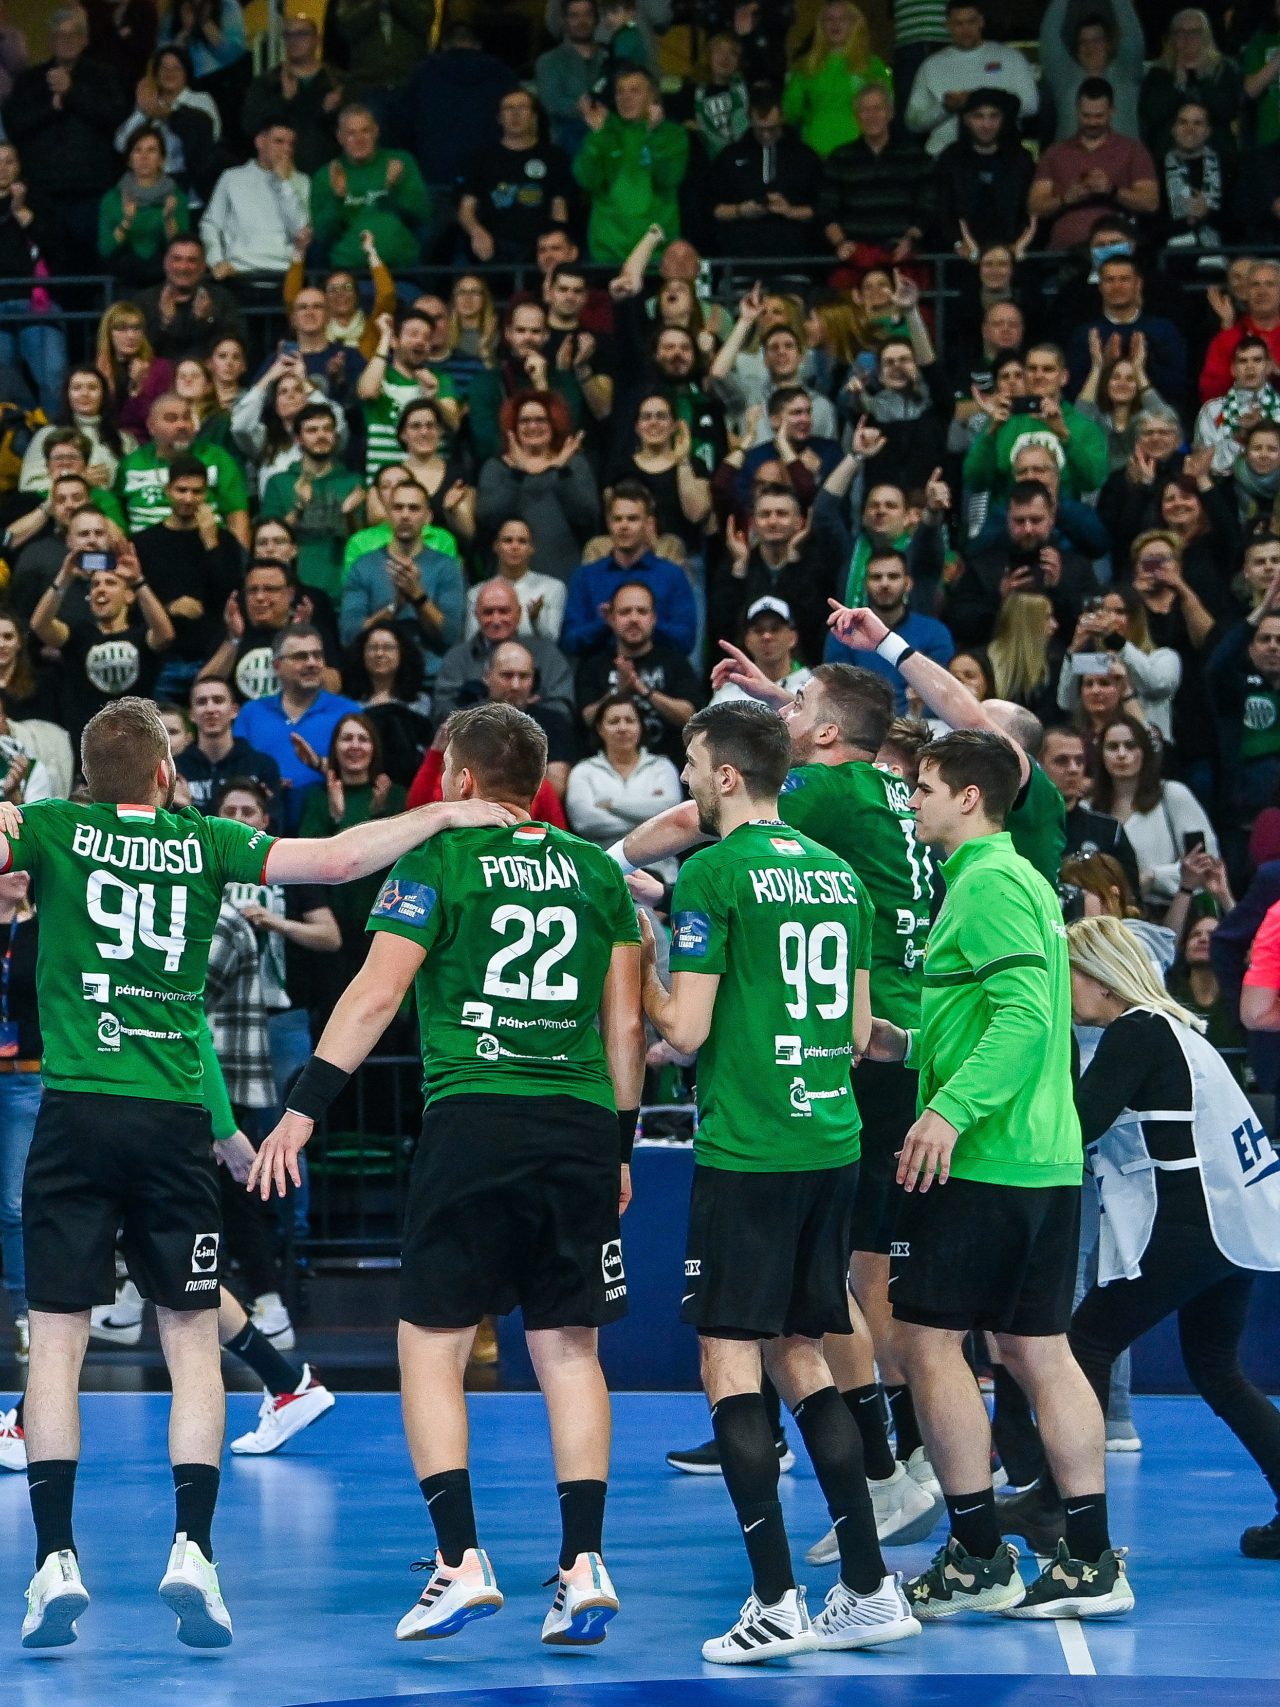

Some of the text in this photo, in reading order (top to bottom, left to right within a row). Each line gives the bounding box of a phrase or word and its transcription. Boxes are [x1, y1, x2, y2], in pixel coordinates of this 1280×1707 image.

[72, 823, 203, 874] BUJDOSÓ
[748, 867, 857, 906] KOVACSICS
[86, 869, 188, 972] 94
[482, 904, 578, 1000] 22
[779, 921, 848, 1019] 99
[115, 985, 197, 1002] pátria nyomda
[497, 1016, 577, 1030] pátria nyomda
